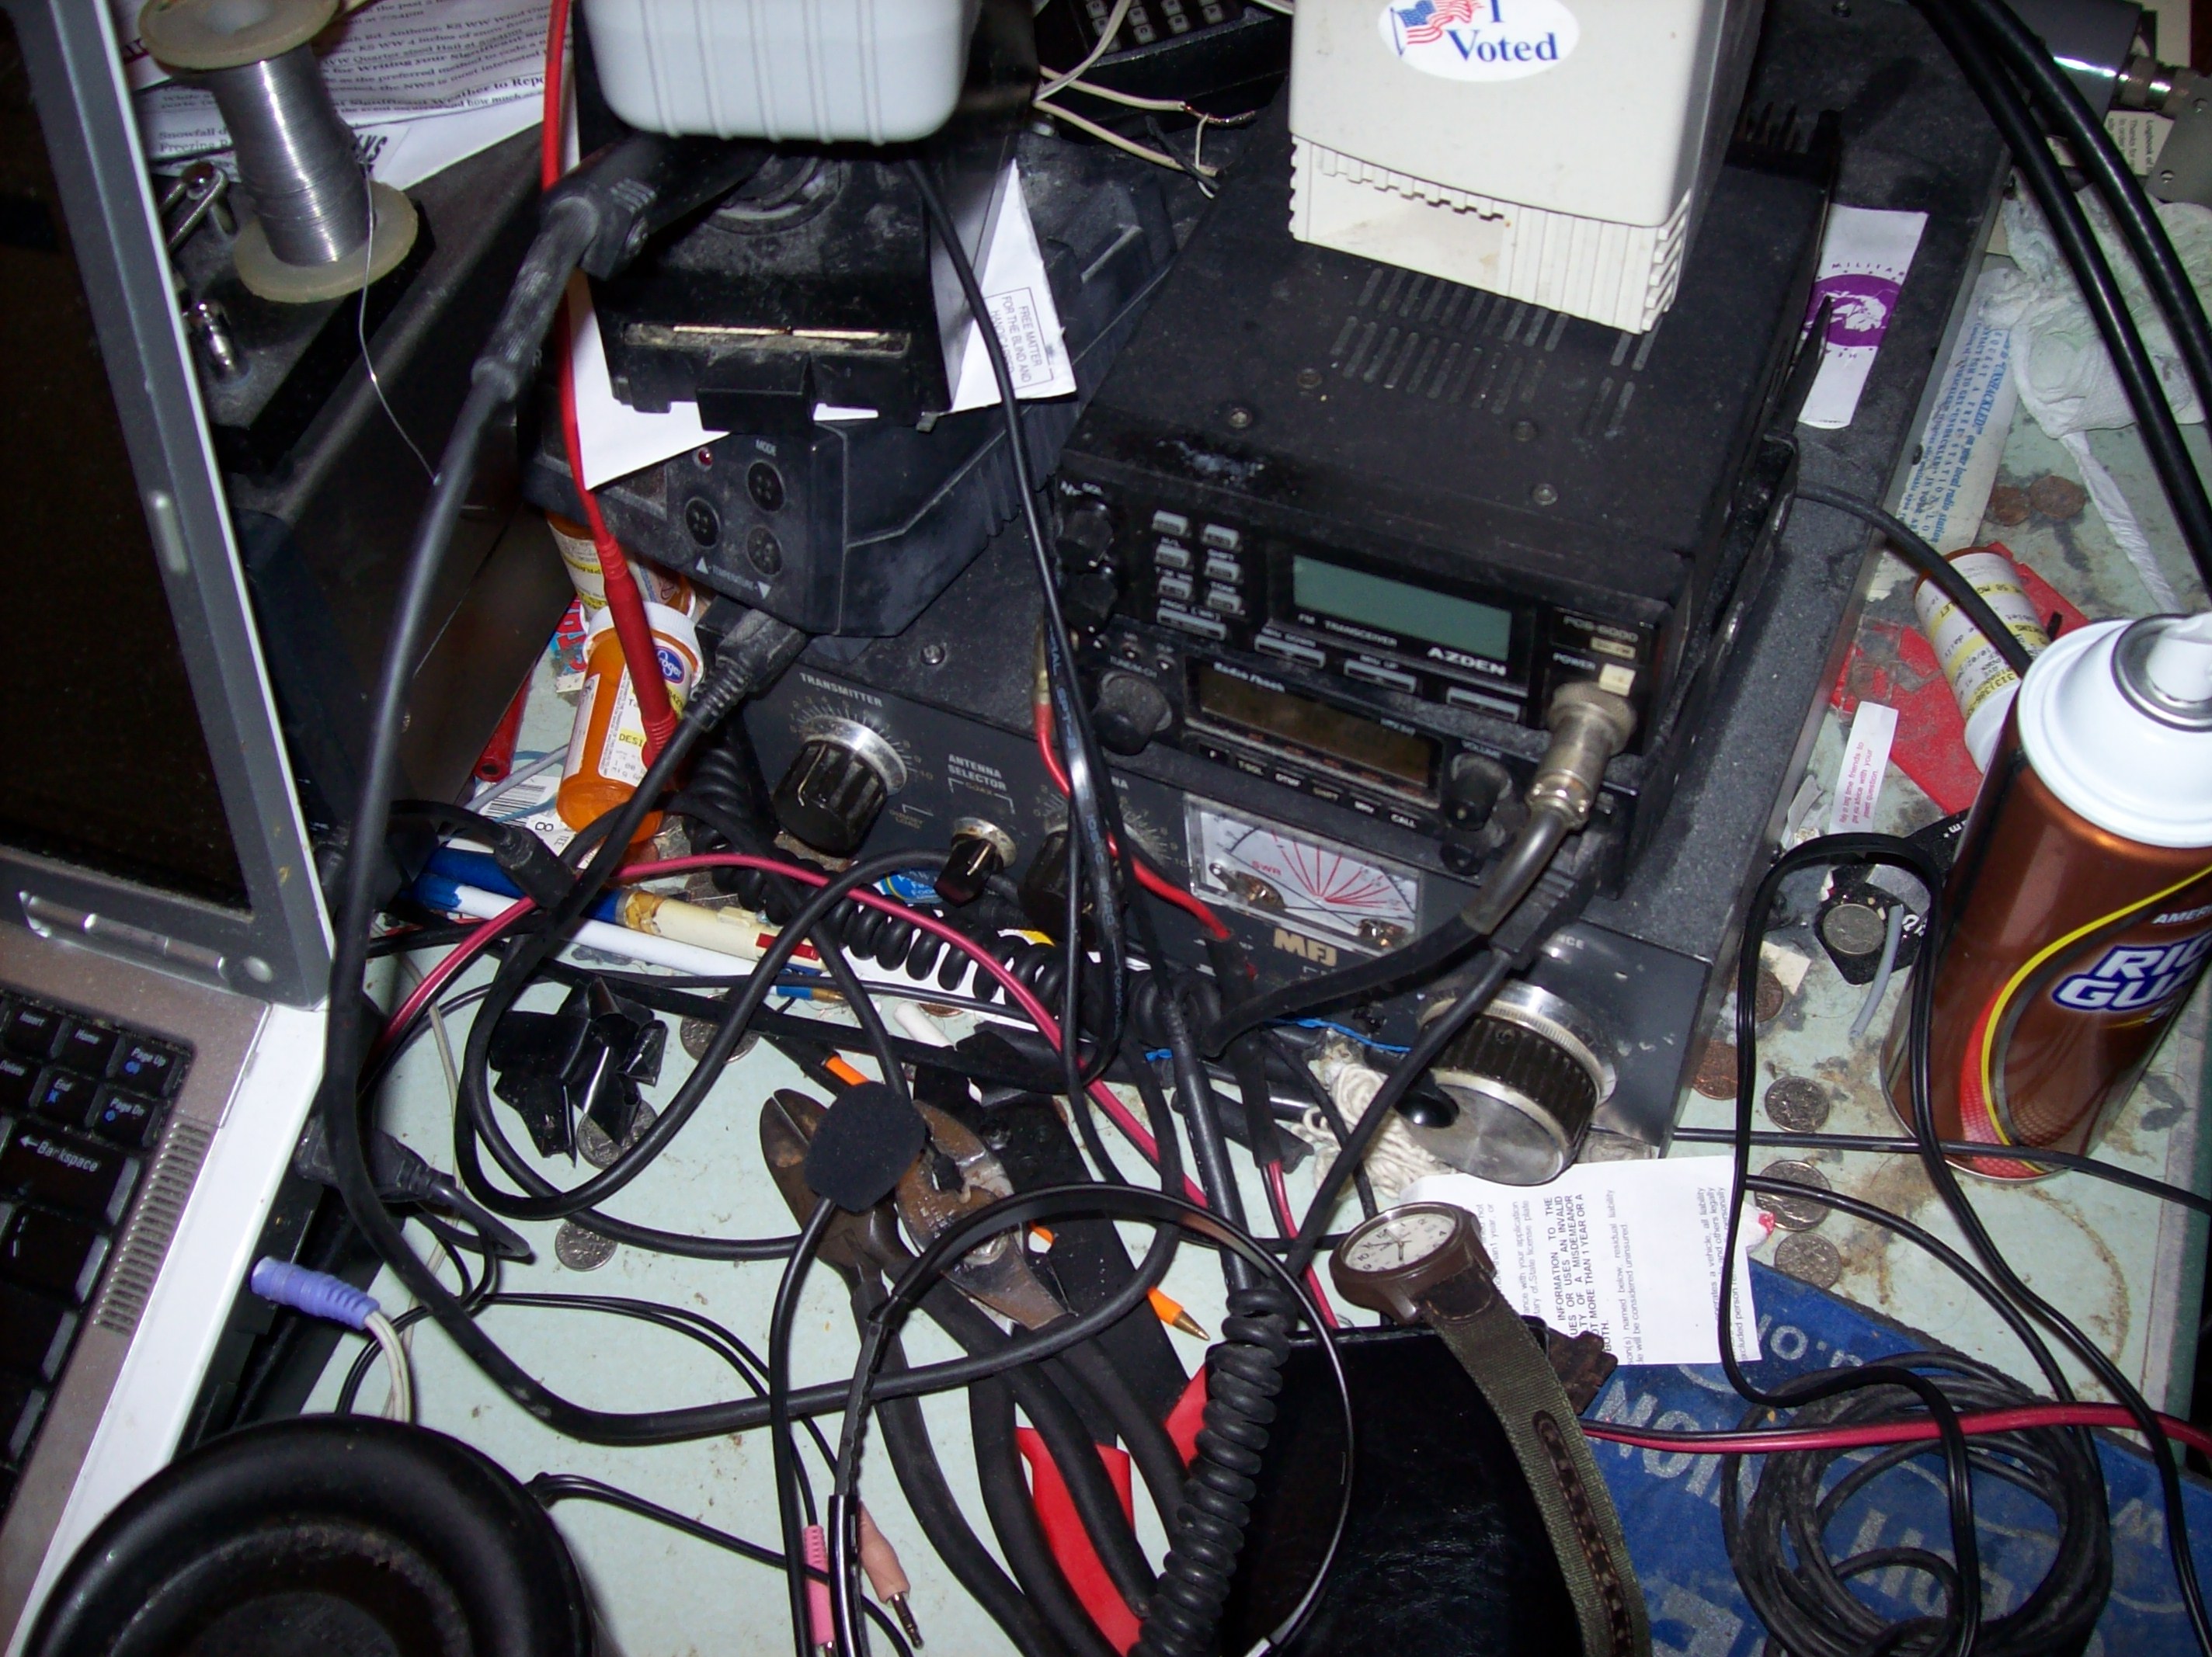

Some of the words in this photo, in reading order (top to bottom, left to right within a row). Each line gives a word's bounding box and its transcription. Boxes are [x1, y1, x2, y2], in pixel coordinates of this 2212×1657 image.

[1490, 0, 1505, 23] I
[1446, 29, 1561, 62] Voted
[494, 80, 509, 89] to
[1002, 296, 1014, 314] FOR
[1007, 315, 1018, 333] THE
[1020, 305, 1031, 329] FREE
[1026, 331, 1041, 366] MATTER
[1012, 335, 1025, 361] BLIND
[1019, 363, 1031, 382] AND
[755, 439, 777, 457] MODE
[1923, 476, 1933, 488] IN
[1949, 465, 1967, 488] local
[1941, 488, 1957, 512] radio
[1930, 512, 1948, 544] station
[1299, 613, 1316, 627] FM
[1324, 620, 1397, 648] TRANSCEIVER
[1427, 647, 1507, 677] AZDEN
[1553, 653, 1596, 671] POWER
[799, 672, 883, 707] TRANSMITTER
[1856, 741, 1864, 750] to
[948, 754, 1002, 779] ANTENNA
[1848, 752, 1861, 779] friends
[1863, 749, 1873, 766] your
[948, 764, 1007, 792] SELECTOR
[1845, 780, 1854, 795] time
[1858, 769, 1867, 784] with
[1865, 769, 1880, 801] question.
[1853, 786, 1864, 804] advice
[1390, 814, 1417, 829] CALL
[1251, 860, 1281, 877] SWR
[1273, 928, 1337, 967] MFJ
[19, 1011, 45, 1027] Insert
[75, 1029, 100, 1046] Home
[130, 1047, 153, 1065] Page
[153, 1054, 166, 1070] Up
[54, 1078, 72, 1093] End
[110, 1097, 131, 1114] Page
[1476, 1203, 1485, 1218] not
[1486, 1204, 1494, 1212] or
[1520, 1200, 1532, 1221] plate
[1543, 1197, 1553, 1215] THE
[1575, 1203, 1585, 1217] OR
[1605, 1189, 1617, 1218] liability
[1696, 1186, 1708, 1215] liability
[1706, 1186, 1719, 1214] legally
[1508, 1200, 1525, 1247] application
[1553, 1195, 1566, 1232] INVALID
[1700, 1218, 1709, 1229] all
[1522, 1225, 1535, 1255] license
[1546, 1226, 1556, 1239] TO
[1564, 1194, 1581, 1267] MISDEMEANOR
[1577, 1219, 1588, 1246] YEAR
[1609, 1222, 1622, 1258] residual
[1710, 1215, 1722, 1244] others
[1558, 1238, 1569, 1252] AN
[1620, 1222, 1633, 1268] uninsured.
[1715, 1245, 1724, 1263] and
[1516, 1250, 1527, 1269] your
[1527, 1259, 1537, 1280] State
[1582, 1258, 1593, 1284] THAN
[1518, 1272, 1528, 1290] with
[1561, 1259, 1573, 1286] USES
[1548, 1251, 1567, 1321] INFORMATION
[1575, 1291, 1585, 1304] OF
[1626, 1270, 1639, 1320] considered
[1564, 1292, 1575, 1307] OR
[1585, 1288, 1597, 1318] MORE
[1730, 1287, 1744, 1319] person
[1567, 1311, 1578, 1335] UES
[1617, 1298, 1629, 1330] named
[1600, 1319, 1612, 1351] BOTH.
[1630, 1322, 1640, 1334] be
[1622, 1336, 1635, 1364] son(s)
[1632, 1335, 1643, 1357] will
